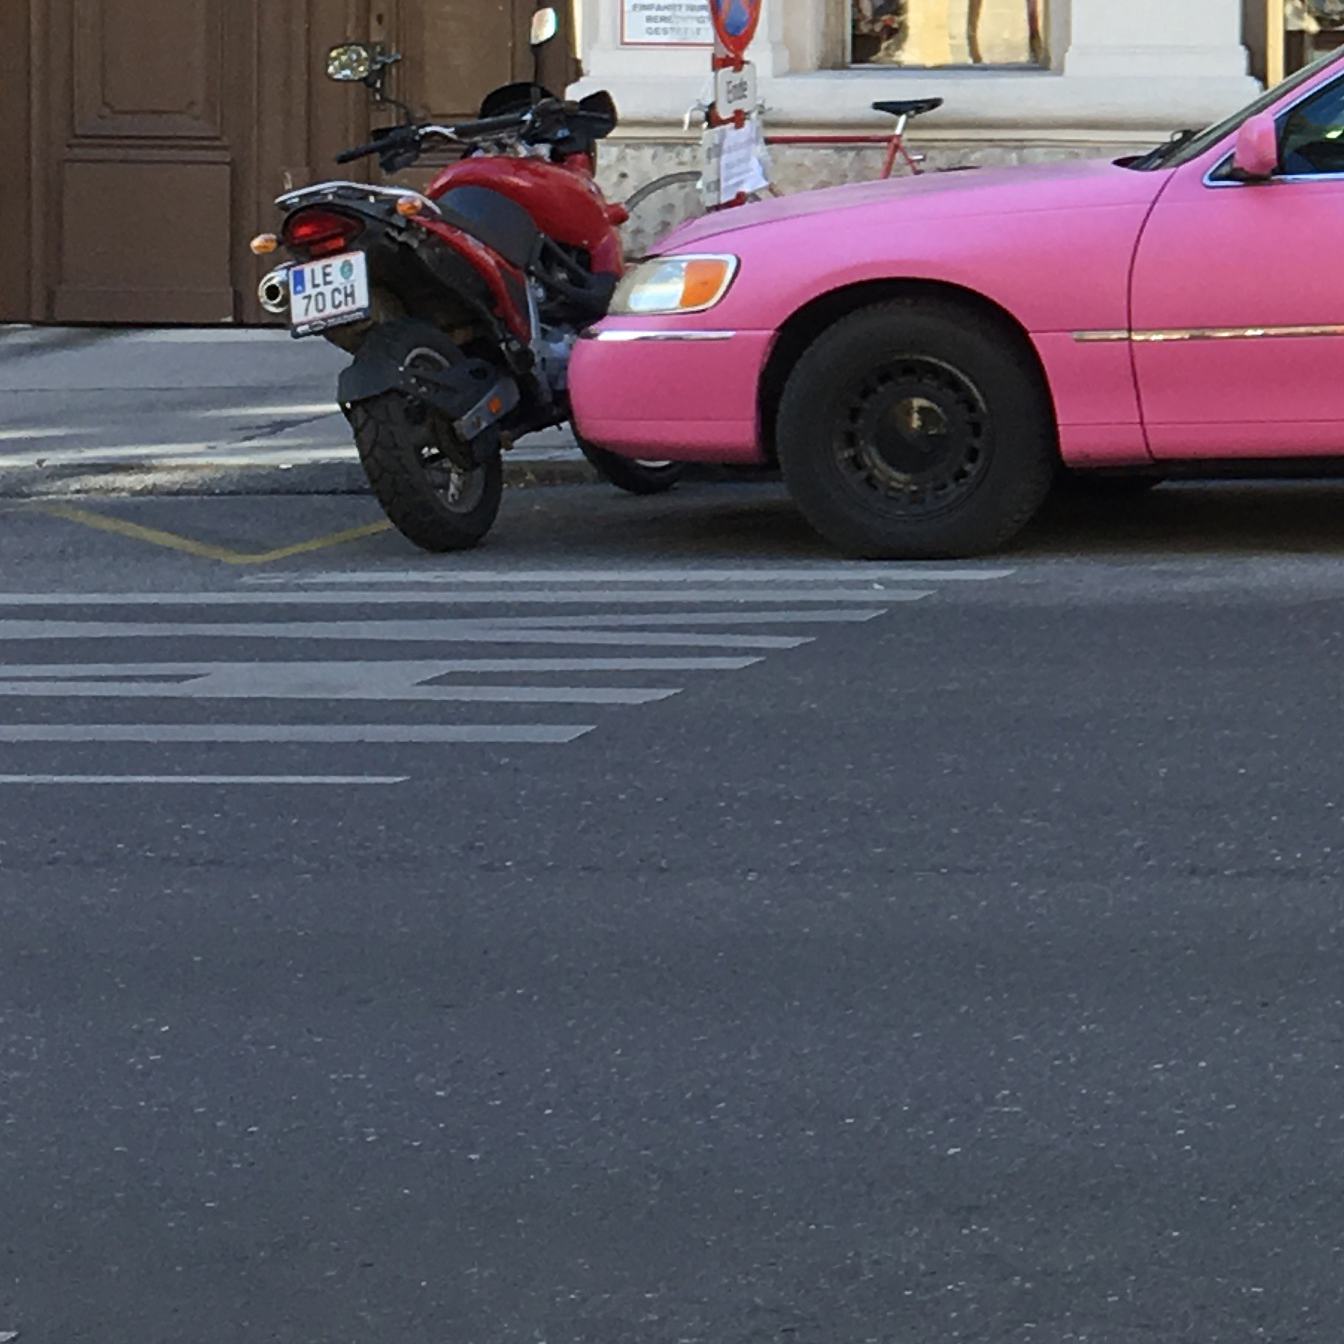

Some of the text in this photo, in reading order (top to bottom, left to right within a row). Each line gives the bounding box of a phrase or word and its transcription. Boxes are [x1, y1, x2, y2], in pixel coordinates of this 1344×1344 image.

[310, 264, 333, 289] LE
[302, 284, 356, 317] 70 CH
